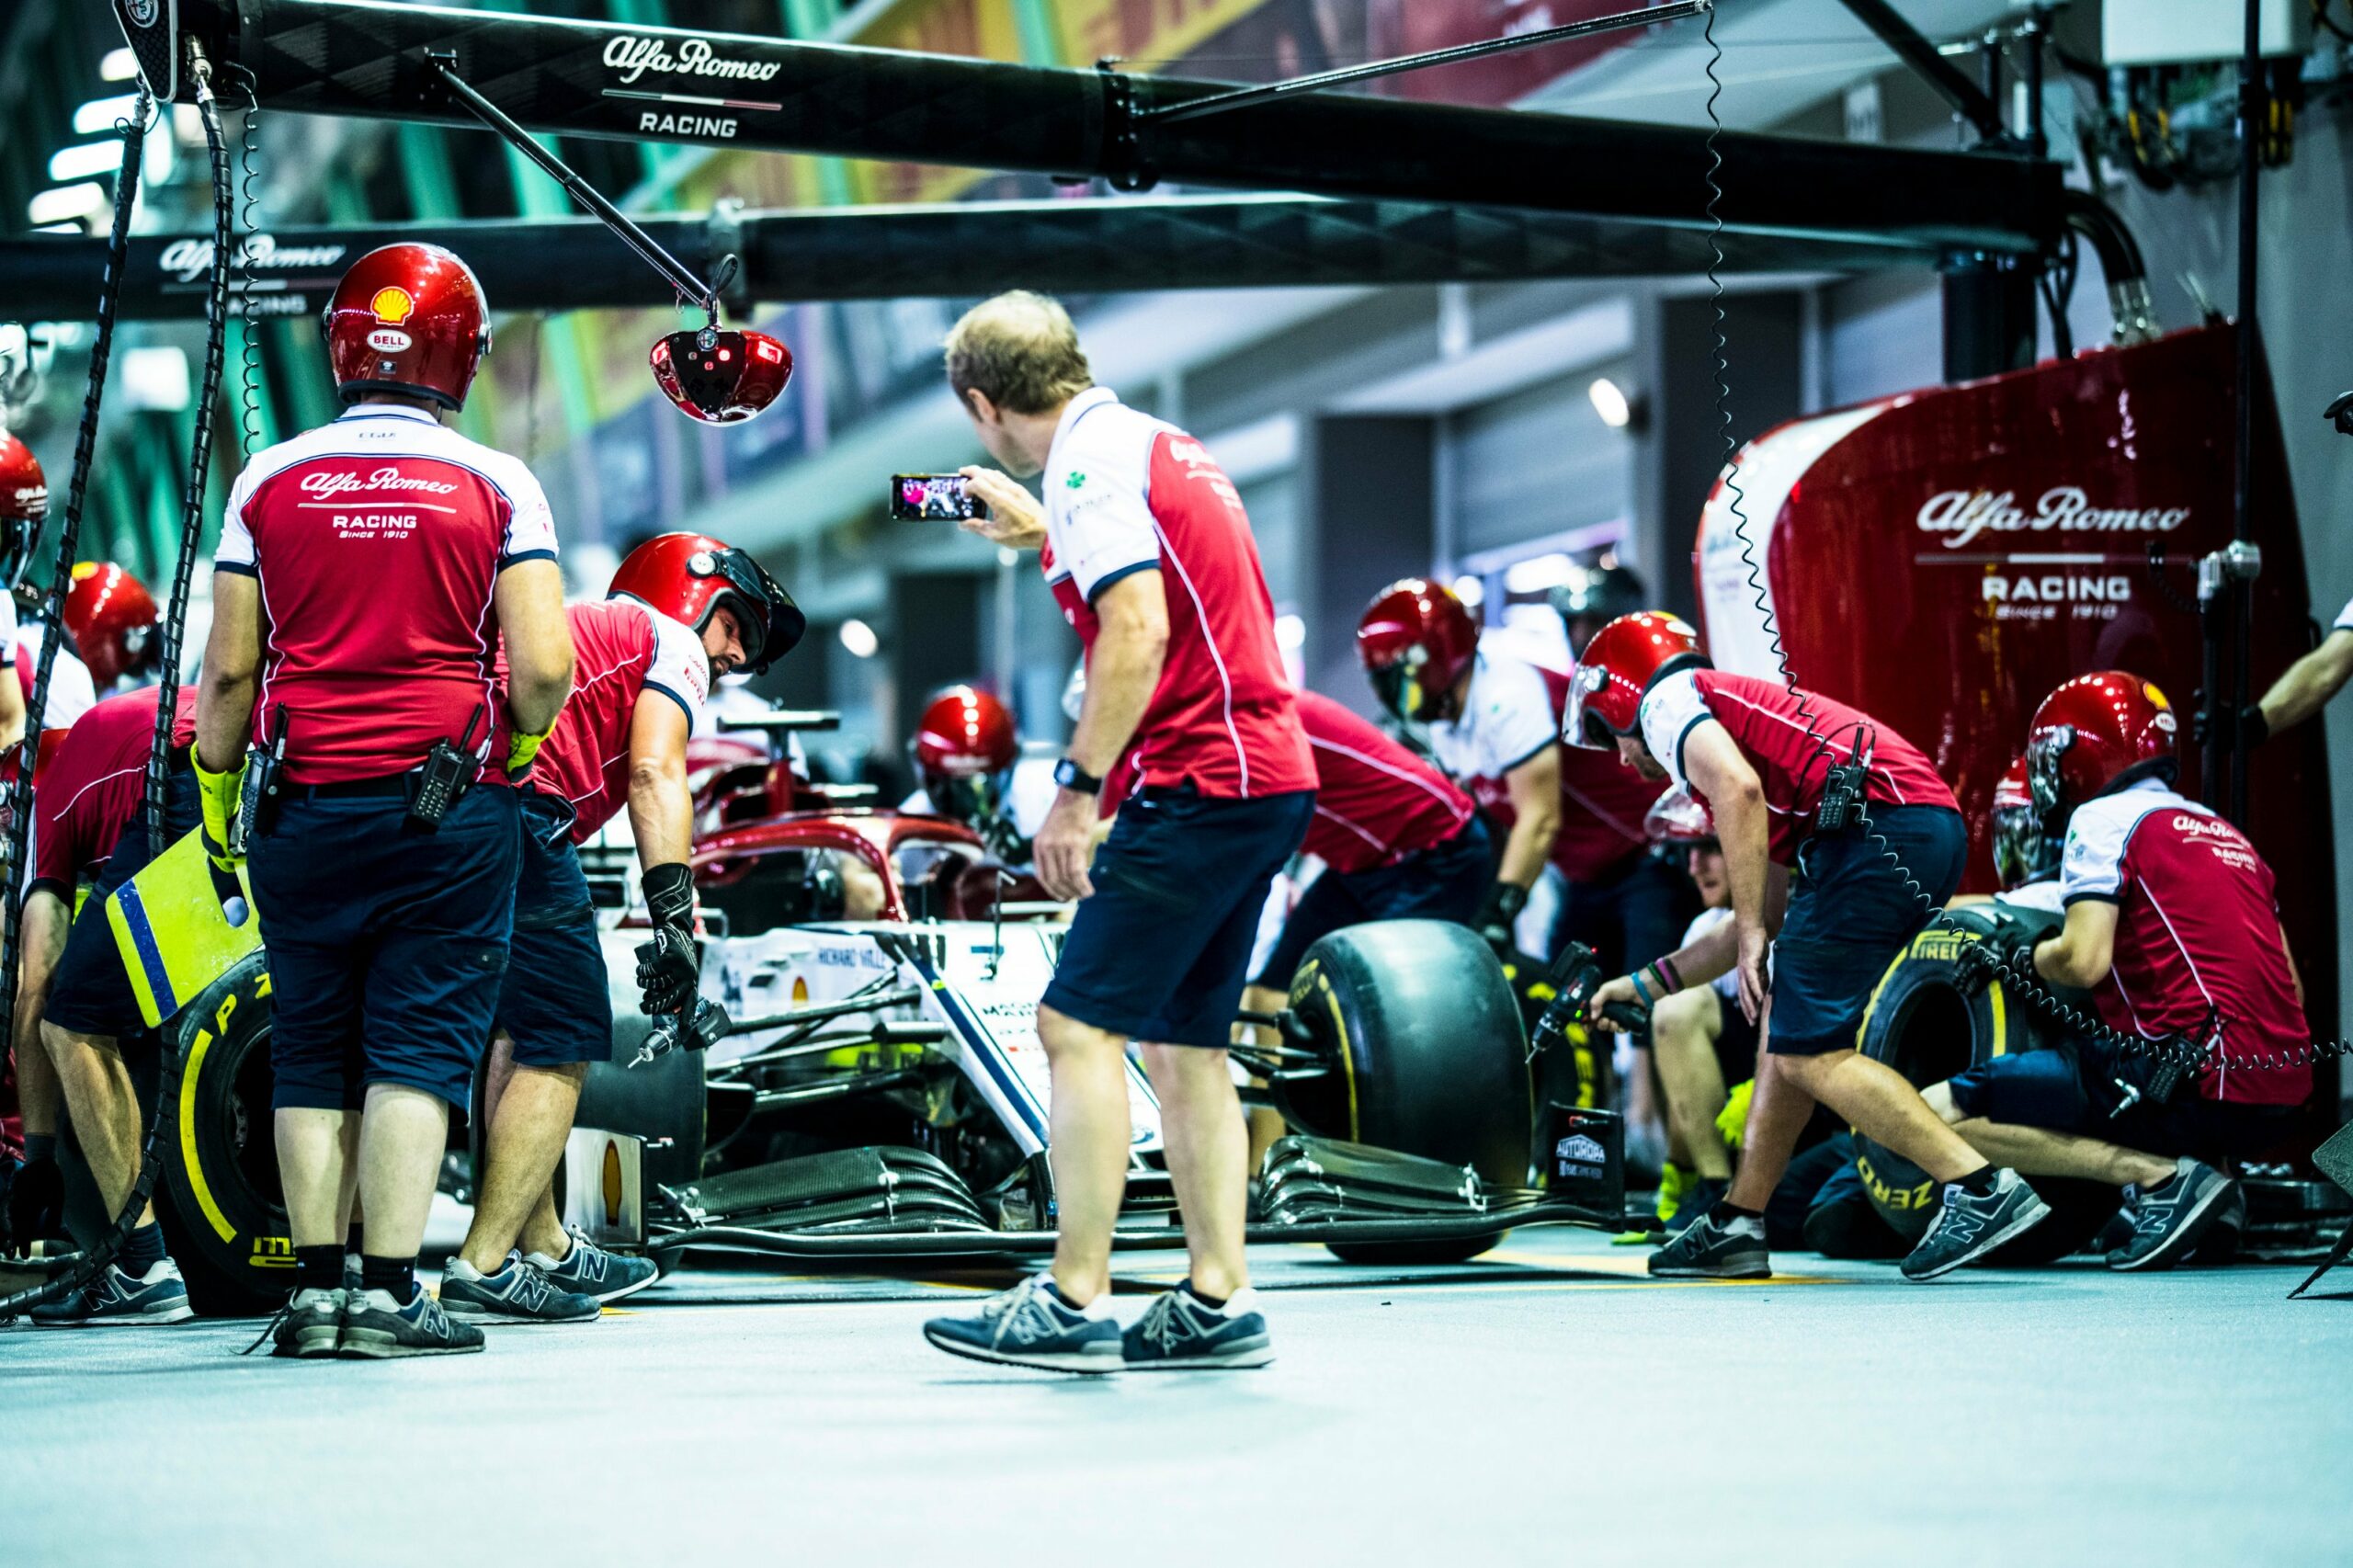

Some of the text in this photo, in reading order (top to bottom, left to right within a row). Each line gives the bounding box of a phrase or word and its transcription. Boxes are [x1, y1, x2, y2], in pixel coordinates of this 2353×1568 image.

[603, 36, 781, 84] Alfa Romeo
[640, 112, 738, 138] RACING
[159, 238, 235, 284] Alf
[373, 335, 404, 346] BELL
[300, 467, 458, 501] Alfa Romeo
[333, 515, 417, 529] RACING
[1915, 485, 2191, 549] Alfa Romeo
[382, 530, 409, 540] 1910
[1982, 575, 2131, 601] RACING
[2071, 603, 2119, 620] 1910
[215, 994, 237, 1037] P
[1556, 1139, 1606, 1163] AUTOROPA
[1857, 1155, 1934, 1210] ZERO
[582, 1251, 608, 1283] N
[510, 1278, 550, 1312] N
